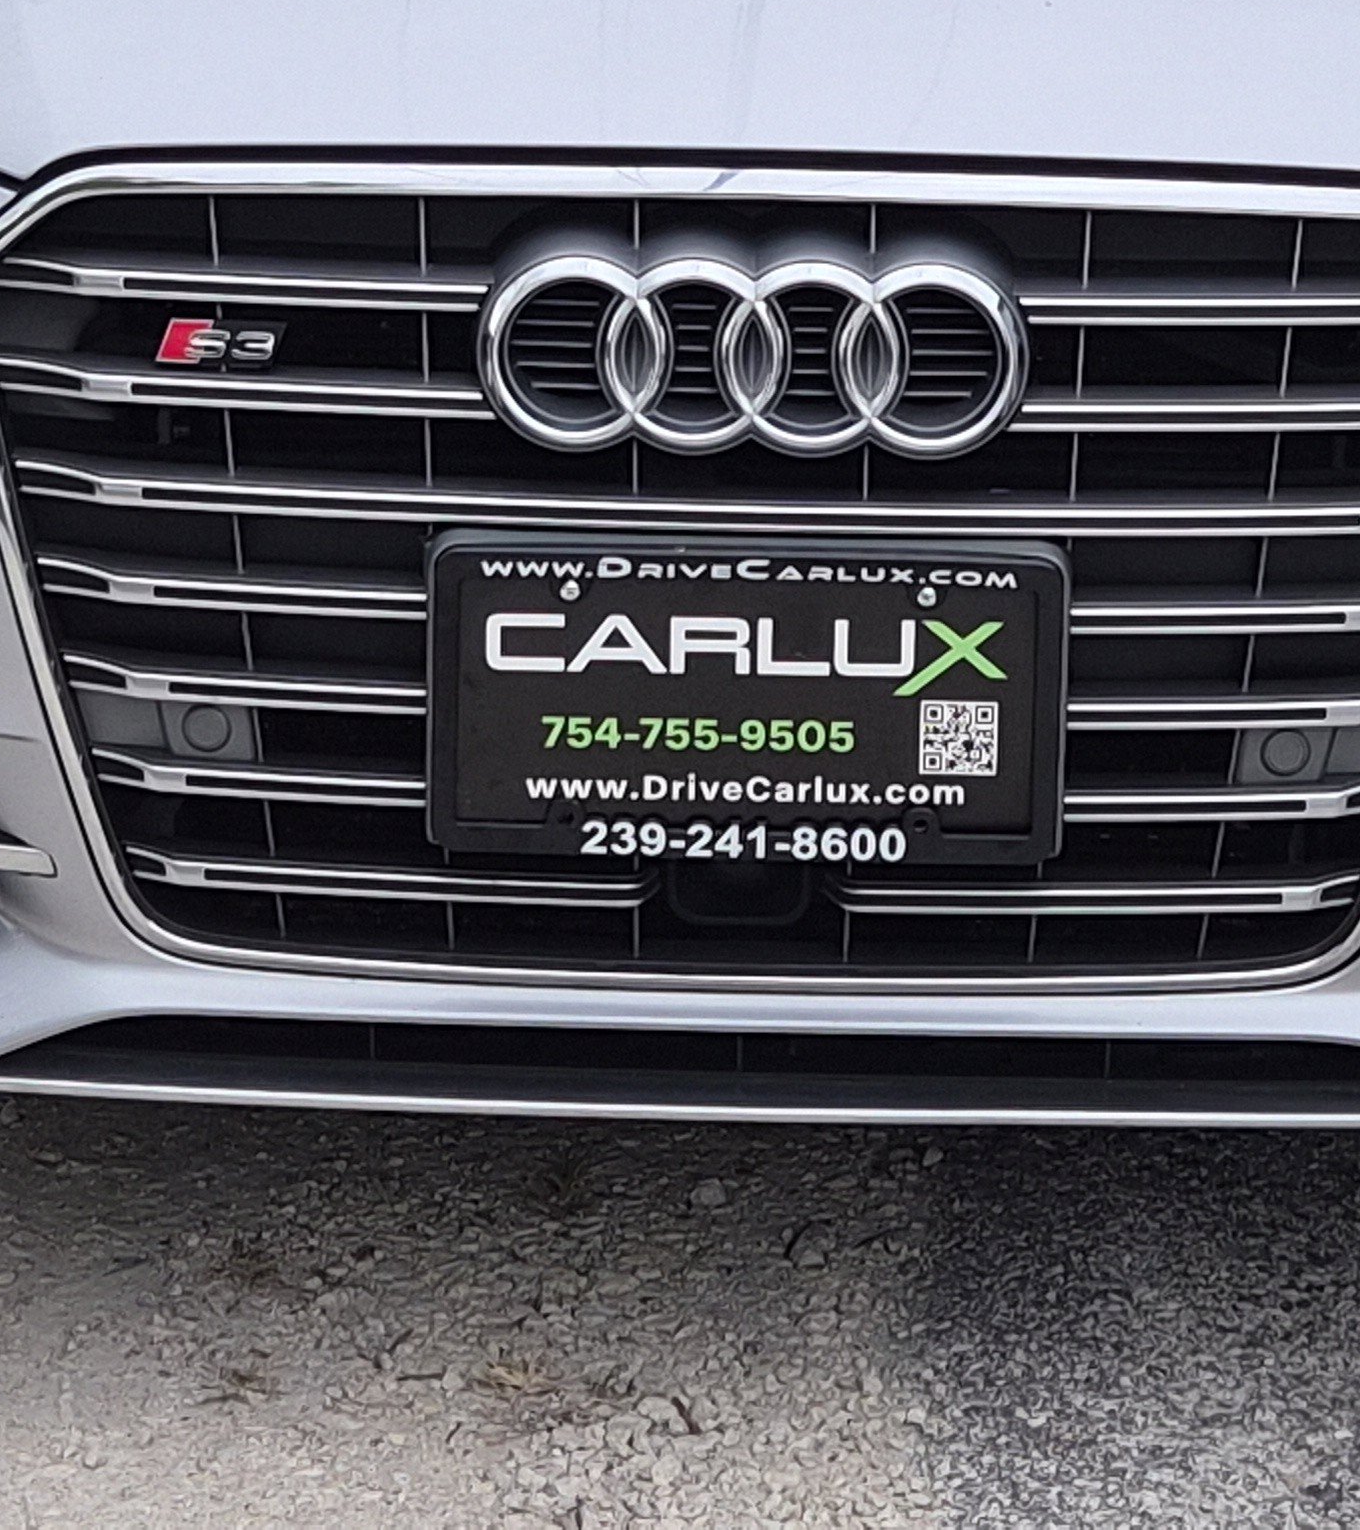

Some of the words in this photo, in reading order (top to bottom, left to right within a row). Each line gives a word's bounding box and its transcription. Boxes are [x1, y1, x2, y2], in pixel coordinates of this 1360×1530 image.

[183, 328, 276, 361] S3
[486, 612, 1008, 697] CARLUX
[540, 715, 856, 754] 754-755-9505
[525, 772, 966, 806] www.DriveCarlux.com
[579, 820, 907, 862] 239-241-8600
